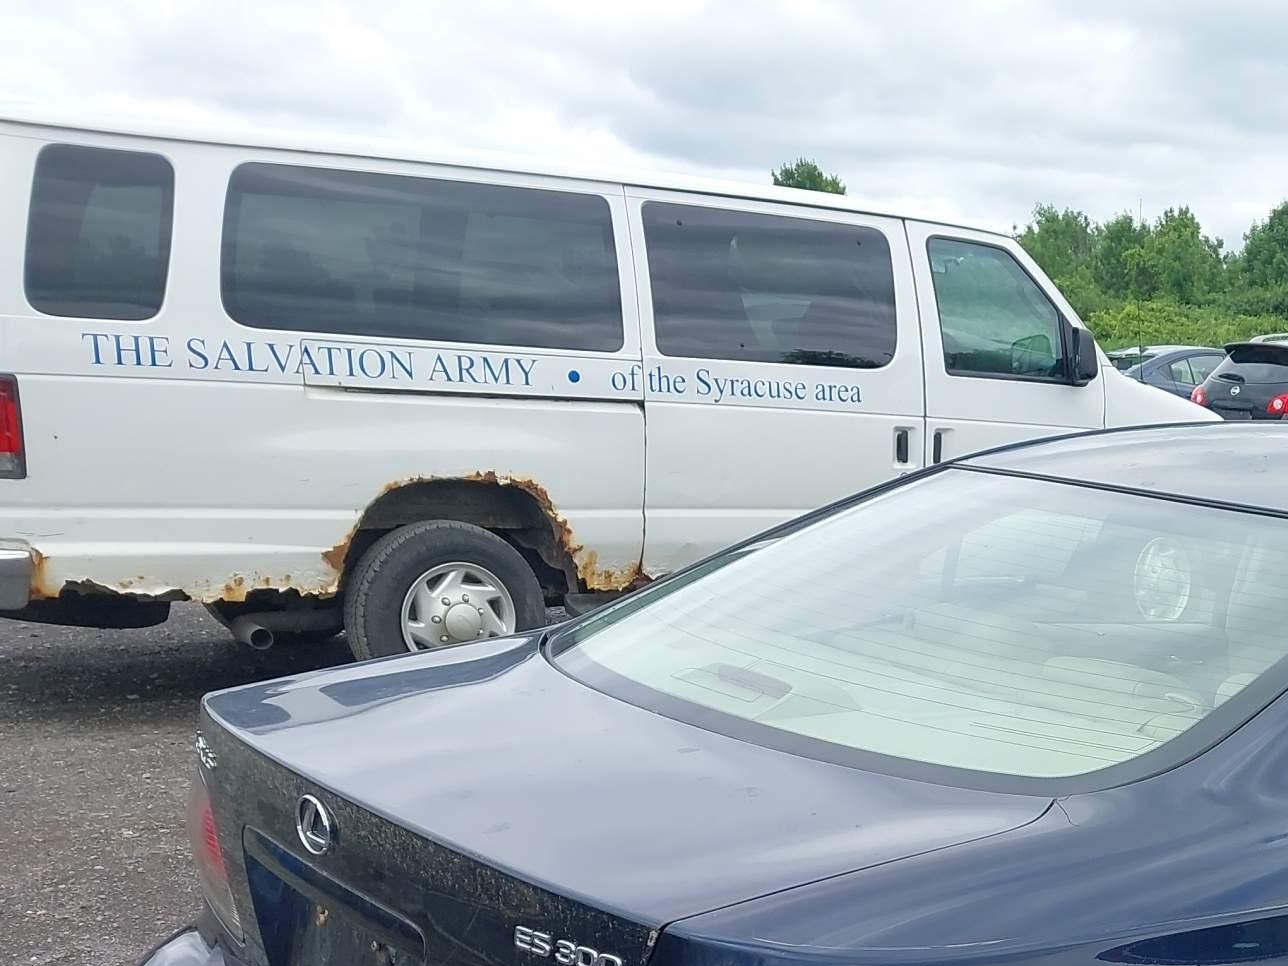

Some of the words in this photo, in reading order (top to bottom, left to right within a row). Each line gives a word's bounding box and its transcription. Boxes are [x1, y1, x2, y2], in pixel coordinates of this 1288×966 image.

[81, 332, 173, 367] THE
[186, 338, 414, 380] SALVATION
[428, 353, 539, 386] ARMY
[611, 365, 641, 391] of
[649, 366, 686, 393] the
[696, 368, 806, 402] Syracuse
[815, 383, 862, 403] area
[514, 925, 552, 957] ES
